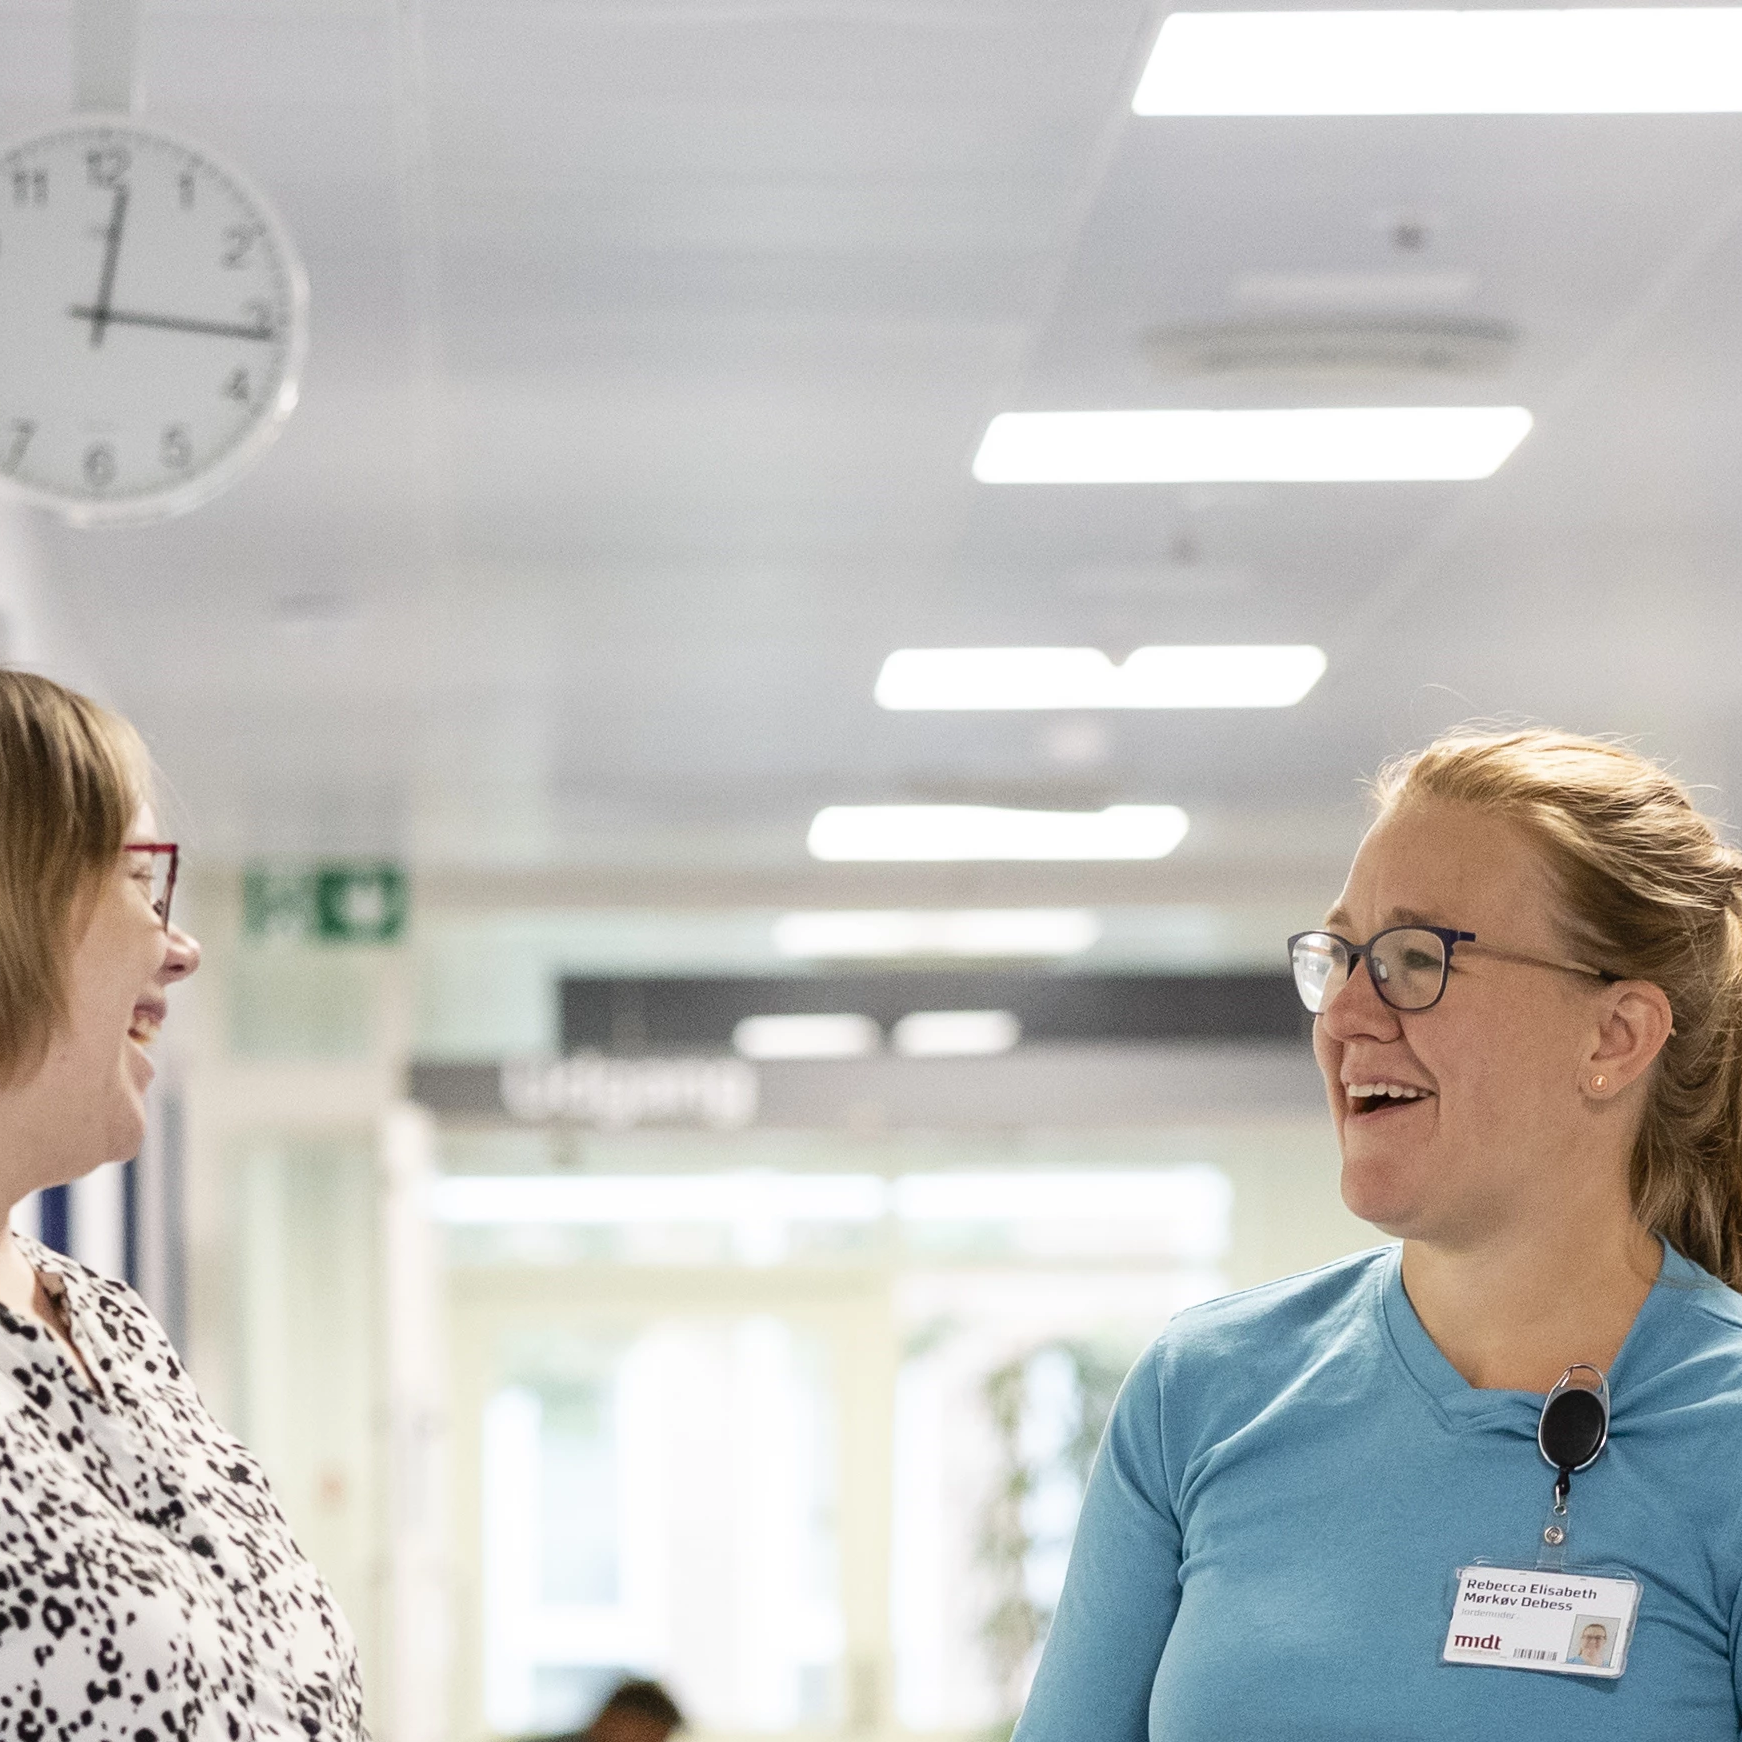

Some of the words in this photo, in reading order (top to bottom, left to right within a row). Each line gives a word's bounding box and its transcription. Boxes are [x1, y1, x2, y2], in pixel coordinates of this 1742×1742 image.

[12, 168, 49, 207] 11
[178, 169, 196, 209] 1
[220, 223, 257, 269] 2
[225, 366, 251, 401] 4
[10, 417, 37, 465] 7
[161, 421, 194, 469] 5
[82, 442, 117, 487] 6
[1463, 1592, 1518, 1607] Mørkøv
[1521, 1596, 1573, 1612] Debess
[1466, 1578, 1527, 1594] Rebecca
[1530, 1583, 1598, 1601] Elisabeth
[1454, 1634, 1503, 1651] midt
